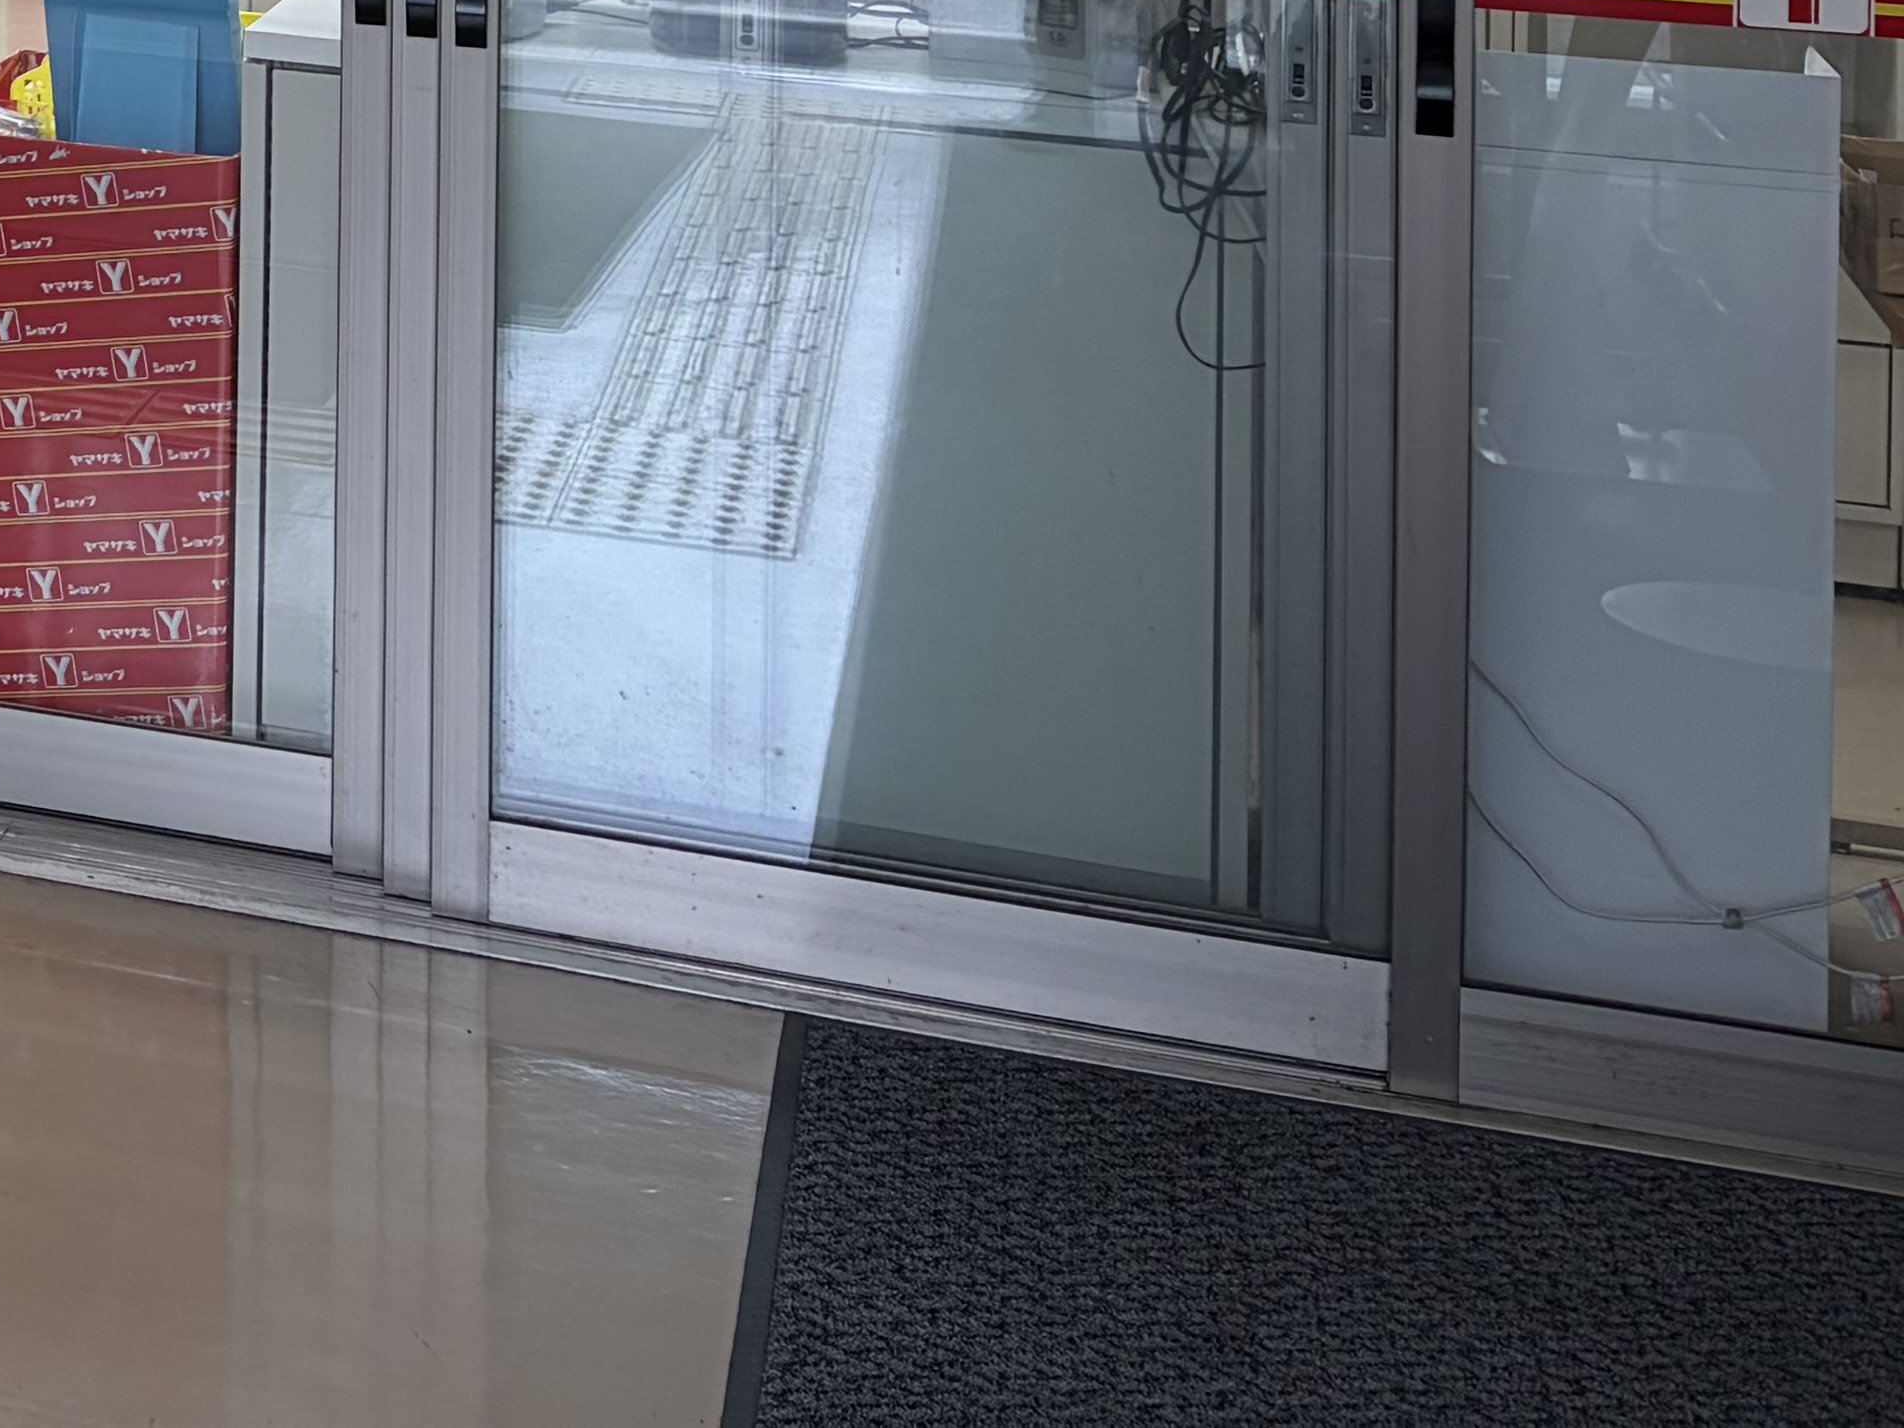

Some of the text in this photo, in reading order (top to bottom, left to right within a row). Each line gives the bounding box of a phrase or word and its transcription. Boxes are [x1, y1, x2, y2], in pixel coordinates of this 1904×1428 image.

[84, 175, 111, 205] Y
[115, 348, 141, 378] Y
[129, 435, 156, 464] Y
[17, 483, 42, 512] Y
